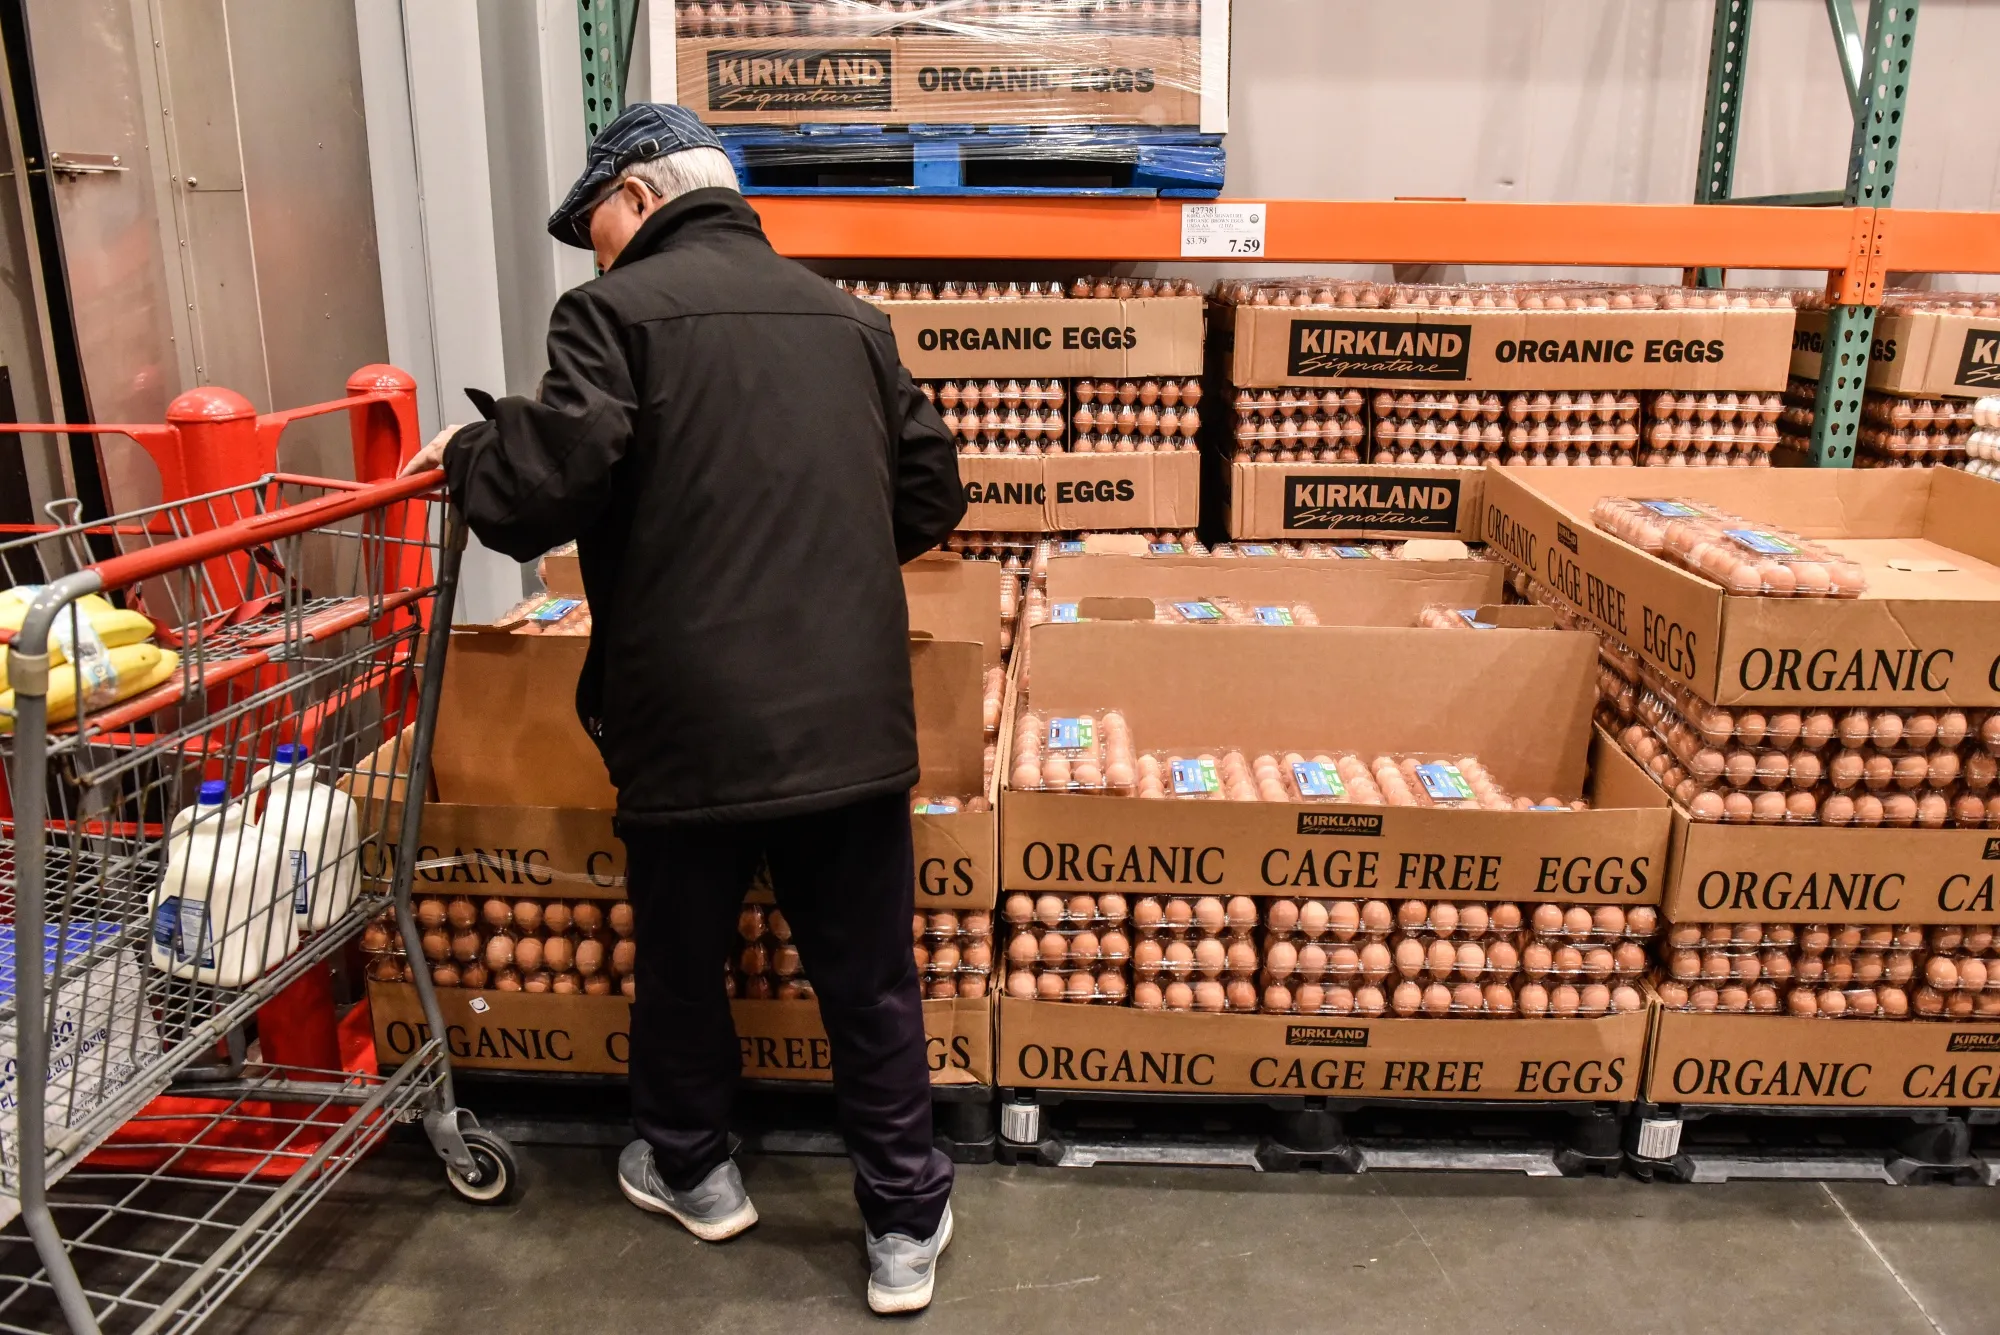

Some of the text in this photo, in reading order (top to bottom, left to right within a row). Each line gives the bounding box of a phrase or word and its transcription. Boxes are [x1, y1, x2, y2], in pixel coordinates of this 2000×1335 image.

[718, 58, 885, 87] KIRKLAND
[918, 66, 1156, 92] ORGANIC EGGS
[718, 87, 884, 111] Signature
[1190, 206, 1217, 214] 427381
[1186, 237, 1207, 245] $3.79
[1229, 239, 1261, 252] 7.59
[917, 326, 1137, 351] ORGANIC EGGS
[1300, 328, 1463, 358] KIRKLAND
[1495, 339, 1725, 363] ORGANIC EGGS
[1298, 354, 1459, 378] Signature
[1056, 479, 1135, 504] EGGS
[1294, 483, 1452, 511] KIRKLAND
[1293, 507, 1449, 530] Signature
[1487, 503, 1537, 572] ORGANIC
[1547, 546, 1583, 607] CAGE
[1586, 572, 1627, 637] FREE
[1642, 605, 1697, 680] EGGS
[1739, 647, 1954, 692] ORGANIC
[1302, 814, 1379, 828] KIRKLAND
[1022, 841, 1650, 896] ORGANIC CAGE FREE EGGS
[1697, 870, 1905, 912] ORGANIC
[1291, 1027, 1365, 1039] KIRKLAND
[739, 1036, 832, 1070] FREE
[1018, 1043, 1625, 1094] ORGANIC CAGE FREE EGGS
[1672, 1057, 1872, 1098] ORGANIC
